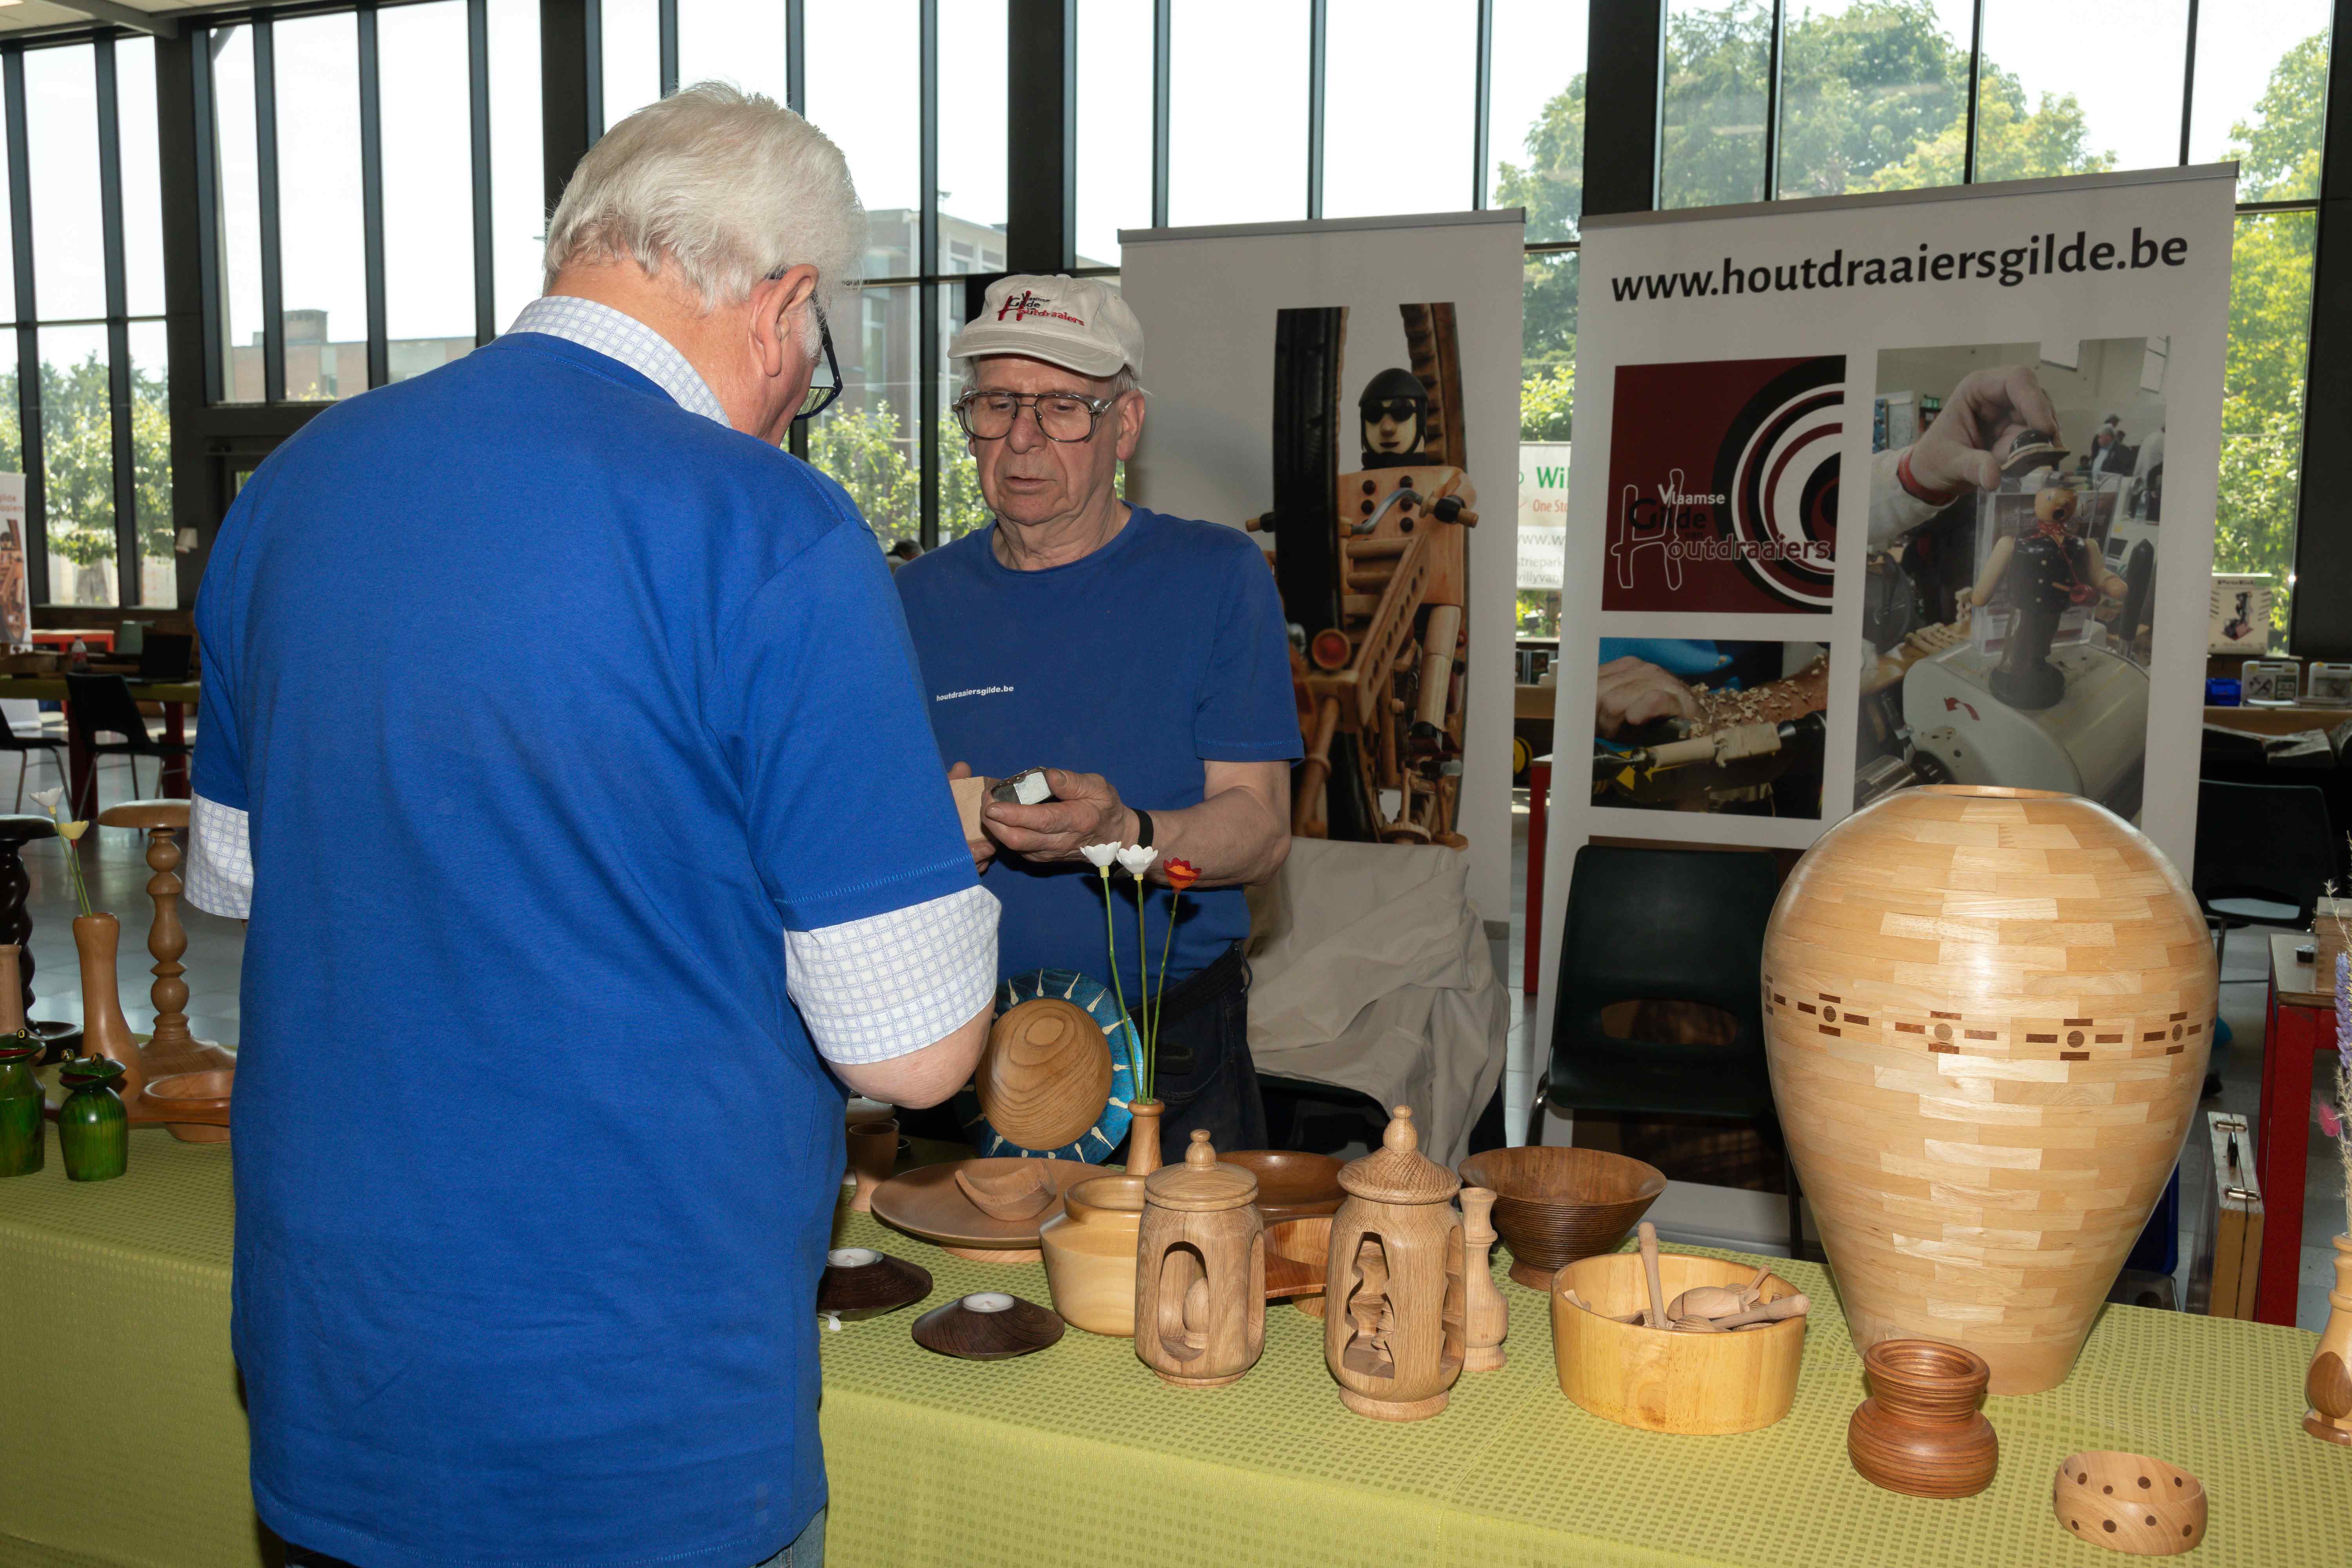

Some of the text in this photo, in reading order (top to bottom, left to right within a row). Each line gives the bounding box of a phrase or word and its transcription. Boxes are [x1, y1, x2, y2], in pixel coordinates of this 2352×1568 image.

[1612, 227, 2188, 302] www.houtdraaiersgilde.be
[1009, 297, 1041, 308] Gilde
[1657, 483, 1725, 505] Vlaamse
[1533, 498, 1552, 513] One
[1628, 498, 1707, 530] Gilde
[936, 685, 1014, 702] houtdraaiersgilde.be
